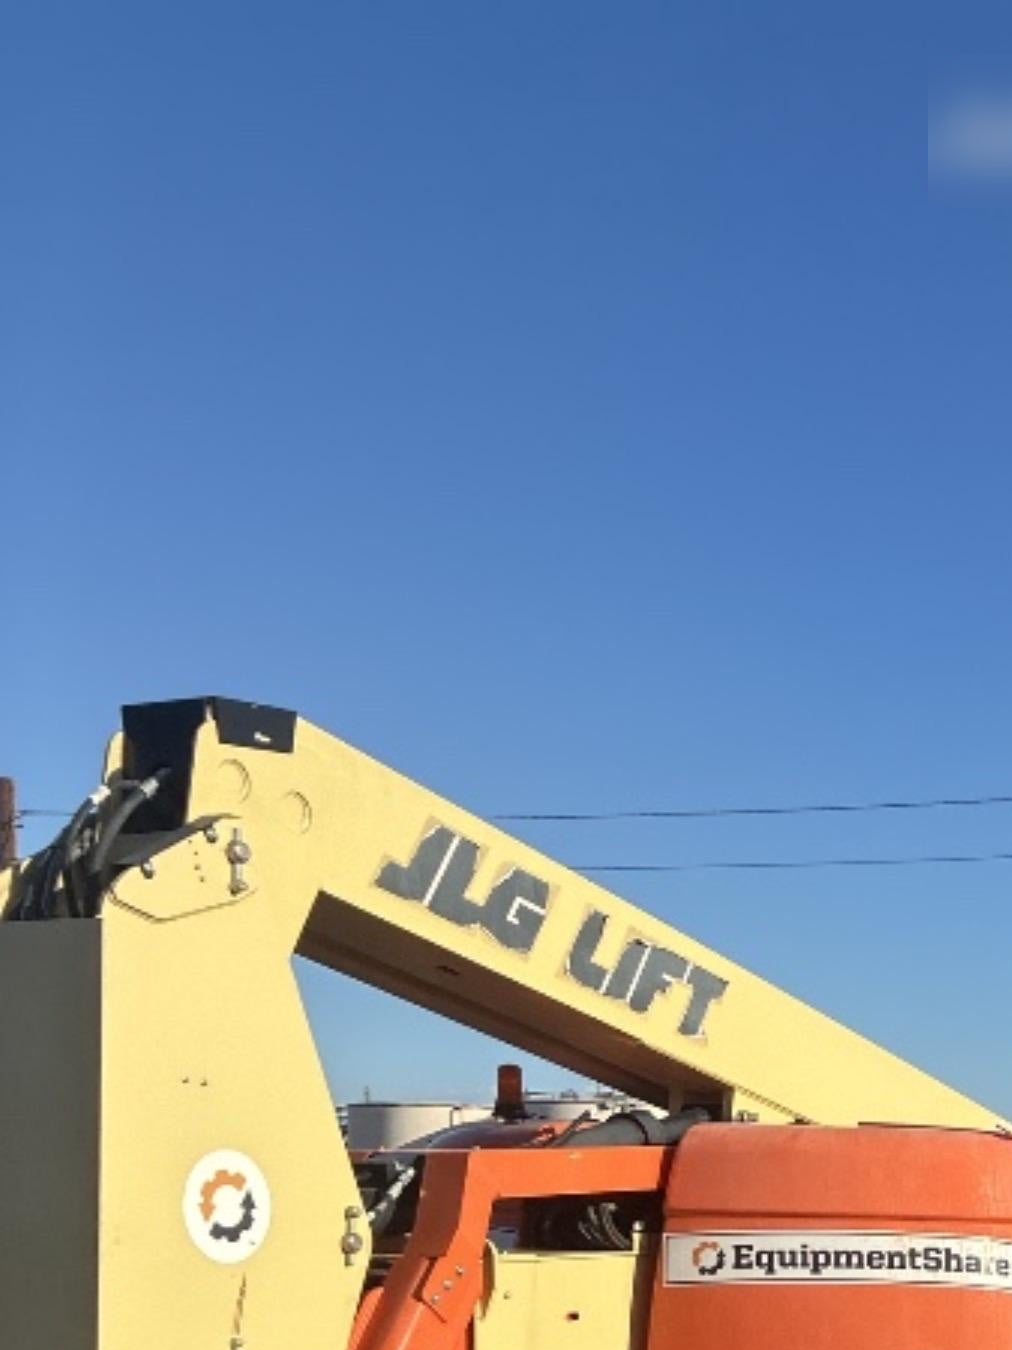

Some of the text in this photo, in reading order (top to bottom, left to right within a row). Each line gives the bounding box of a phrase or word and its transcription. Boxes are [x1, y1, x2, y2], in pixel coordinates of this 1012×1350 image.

[374, 824, 731, 1038] JLG LIFT
[731, 1244, 1010, 1277] EquipmentShare
